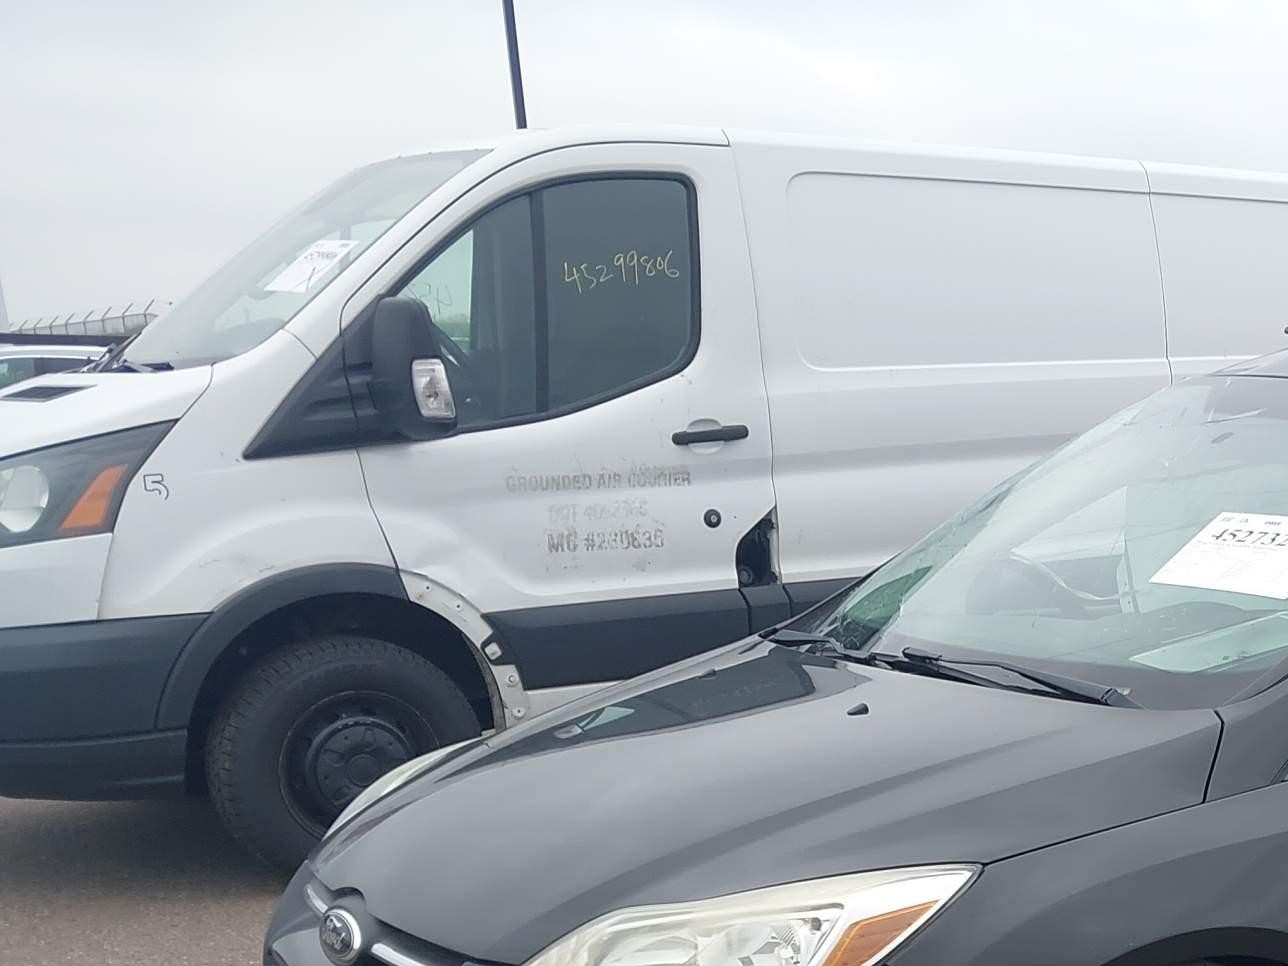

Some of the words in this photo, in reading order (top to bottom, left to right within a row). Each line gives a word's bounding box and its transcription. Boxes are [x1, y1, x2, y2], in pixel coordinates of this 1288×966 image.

[564, 250, 680, 294] 45299806
[505, 473, 592, 493] GROUNDED
[597, 472, 623, 489] AIR
[547, 528, 578, 553] MC
